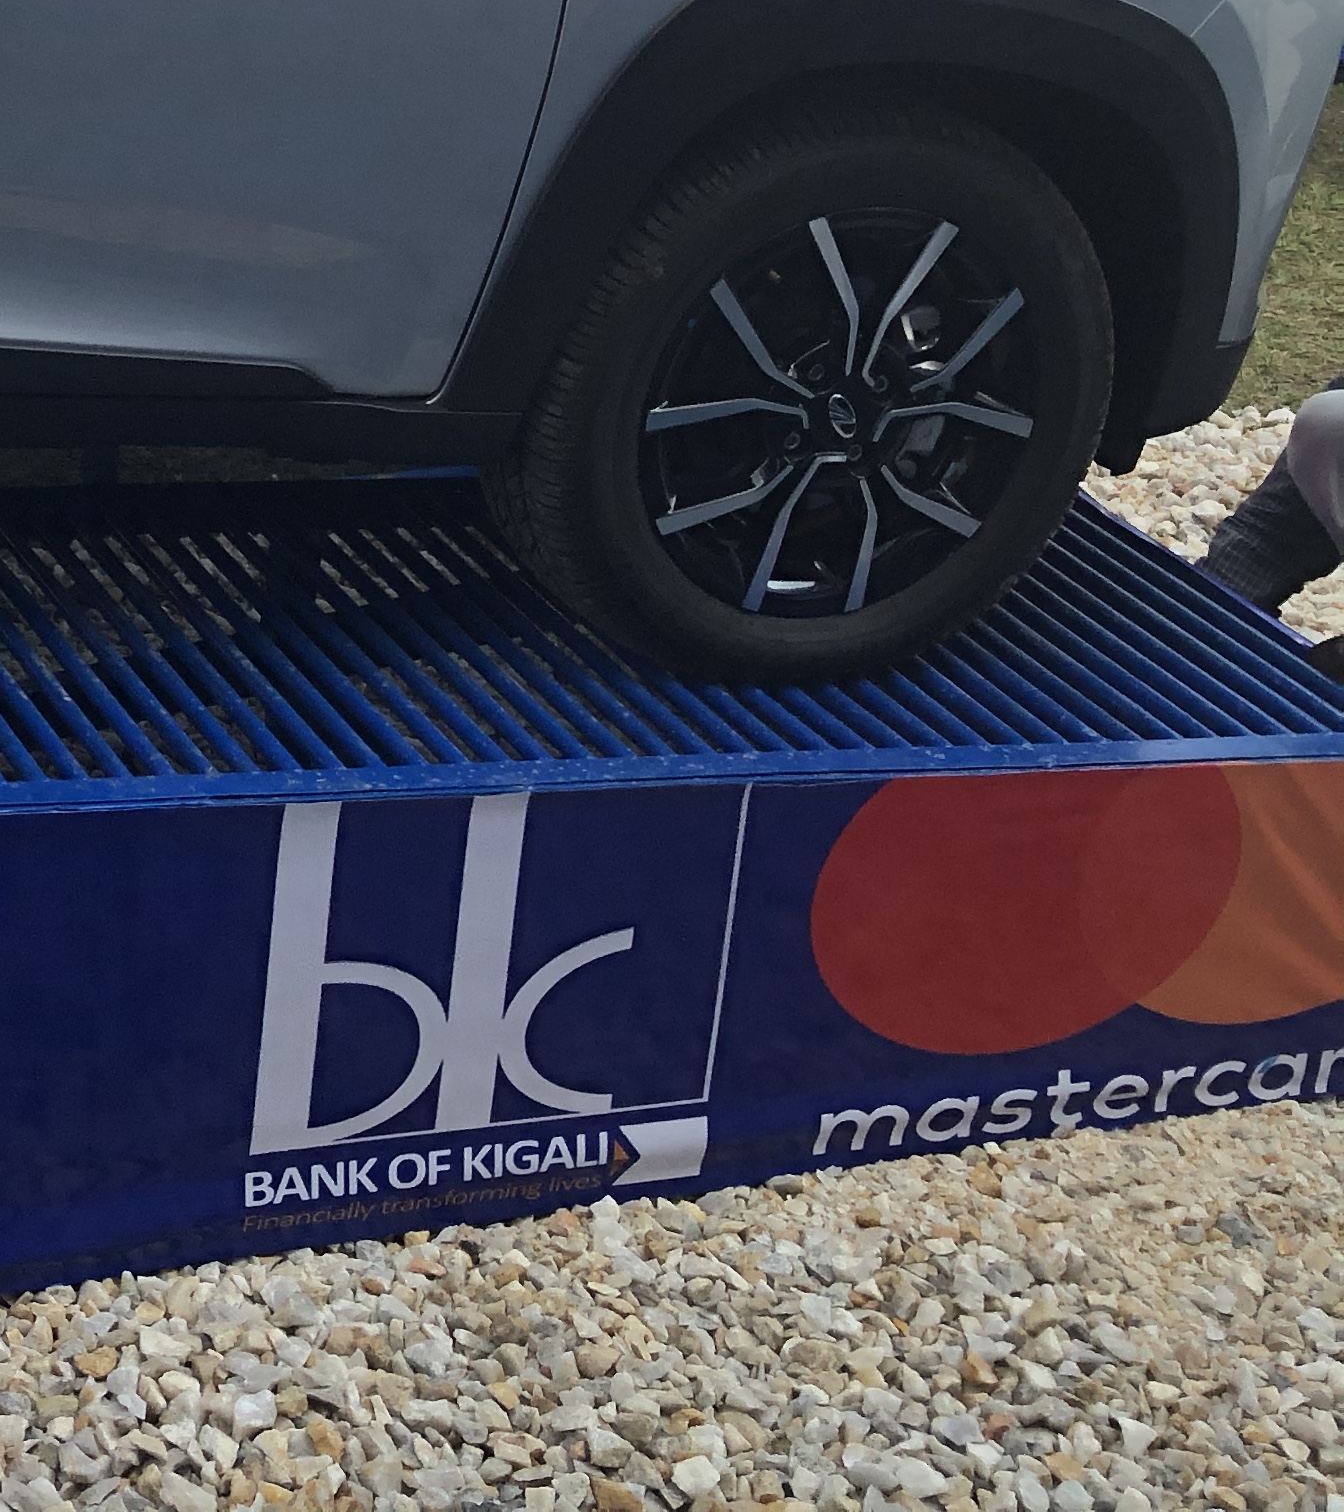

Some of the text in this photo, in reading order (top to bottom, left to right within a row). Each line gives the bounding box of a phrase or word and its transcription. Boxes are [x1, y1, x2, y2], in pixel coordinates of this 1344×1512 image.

[242, 1171, 602, 1234] Financially transforming lives
[244, 1130, 608, 1208] BANK OF KIGALI
